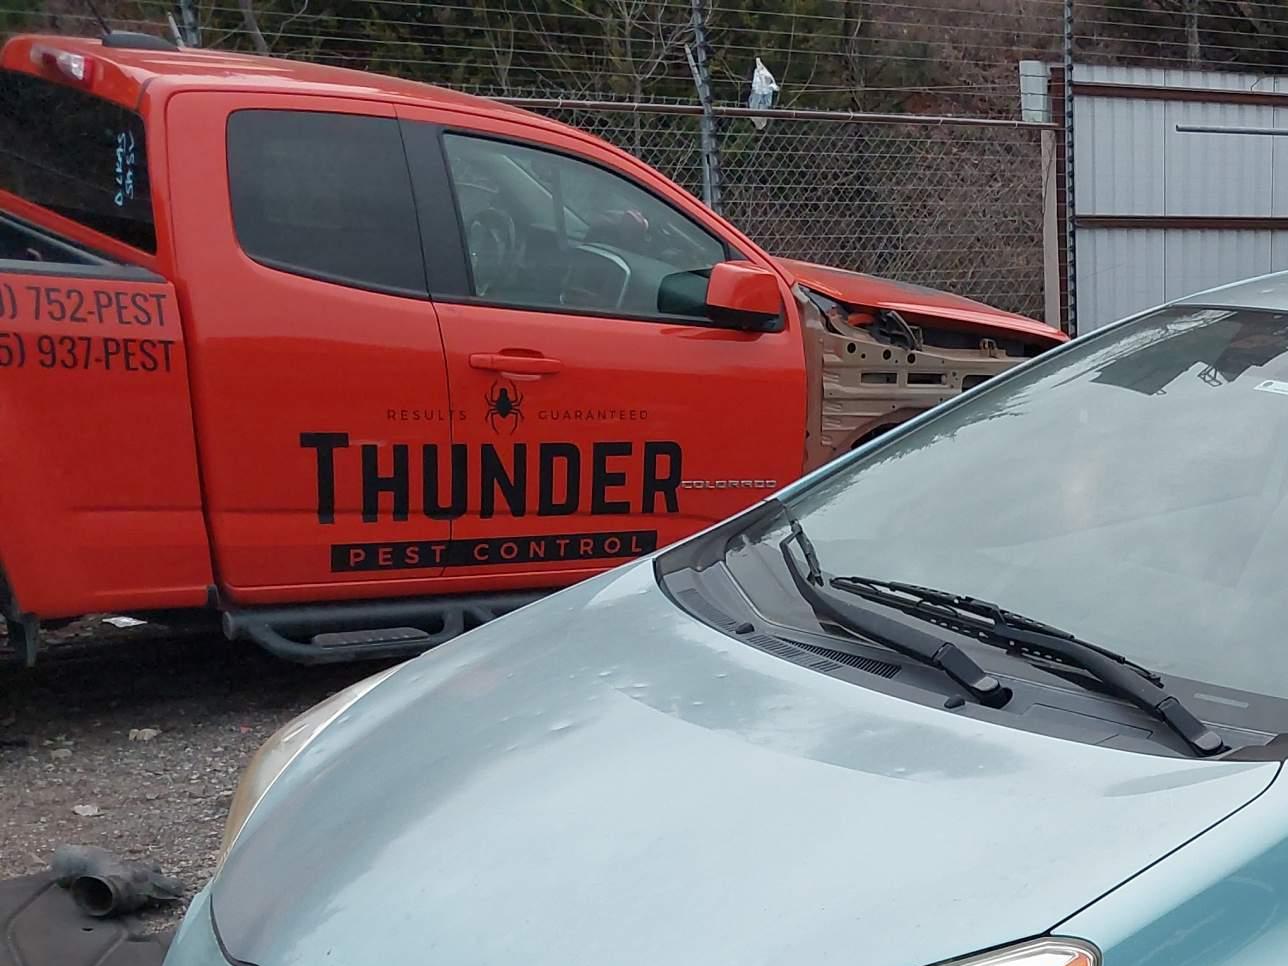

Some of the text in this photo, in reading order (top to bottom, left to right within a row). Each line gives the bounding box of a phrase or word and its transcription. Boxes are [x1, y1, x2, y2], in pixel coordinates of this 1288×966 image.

[26, 286, 167, 327] 752-PEST
[37, 334, 175, 373] 937-PEST
[387, 409, 649, 421] RESULTS GUARANTEED
[300, 432, 683, 525] THUNDER
[681, 480, 777, 489] COLORADO
[349, 536, 643, 568] PEST CONTROL
